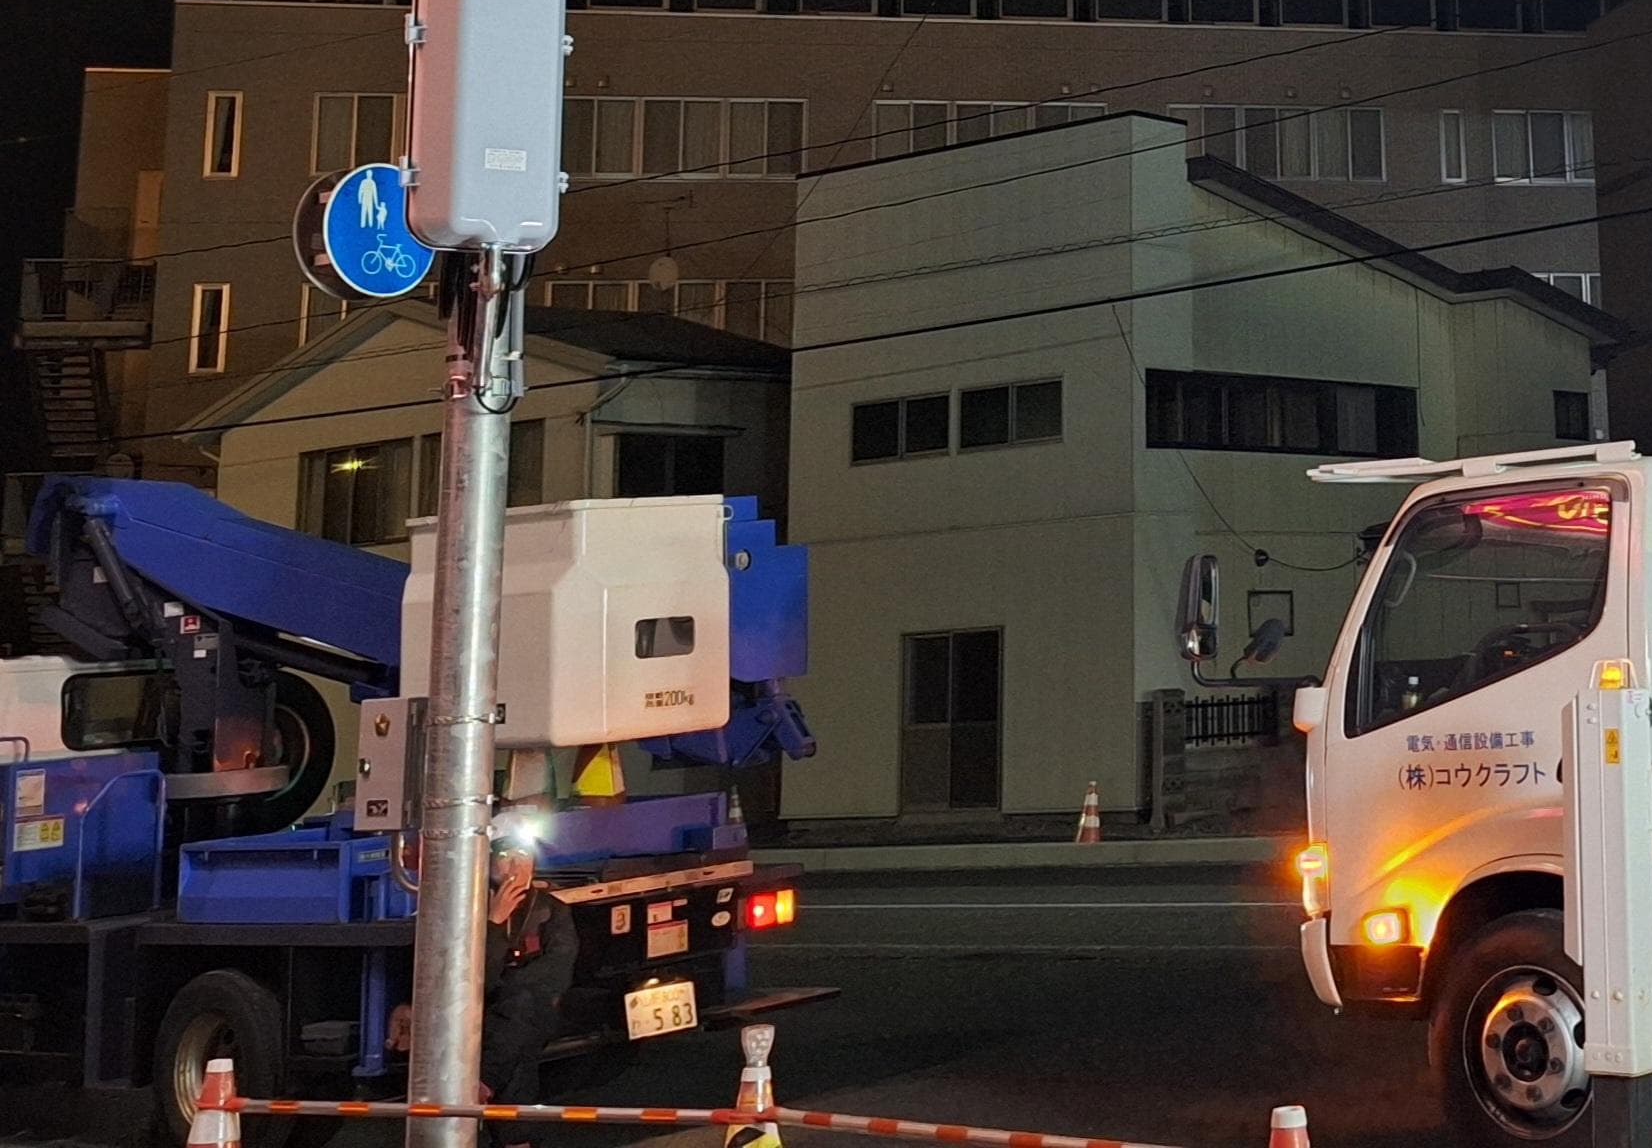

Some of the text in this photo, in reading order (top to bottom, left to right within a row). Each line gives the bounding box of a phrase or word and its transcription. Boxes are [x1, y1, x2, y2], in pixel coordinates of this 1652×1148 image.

[1406, 730, 1535, 753] 電気・通信設備工事
[1398, 761, 1546, 790] (株)コウクラフト
